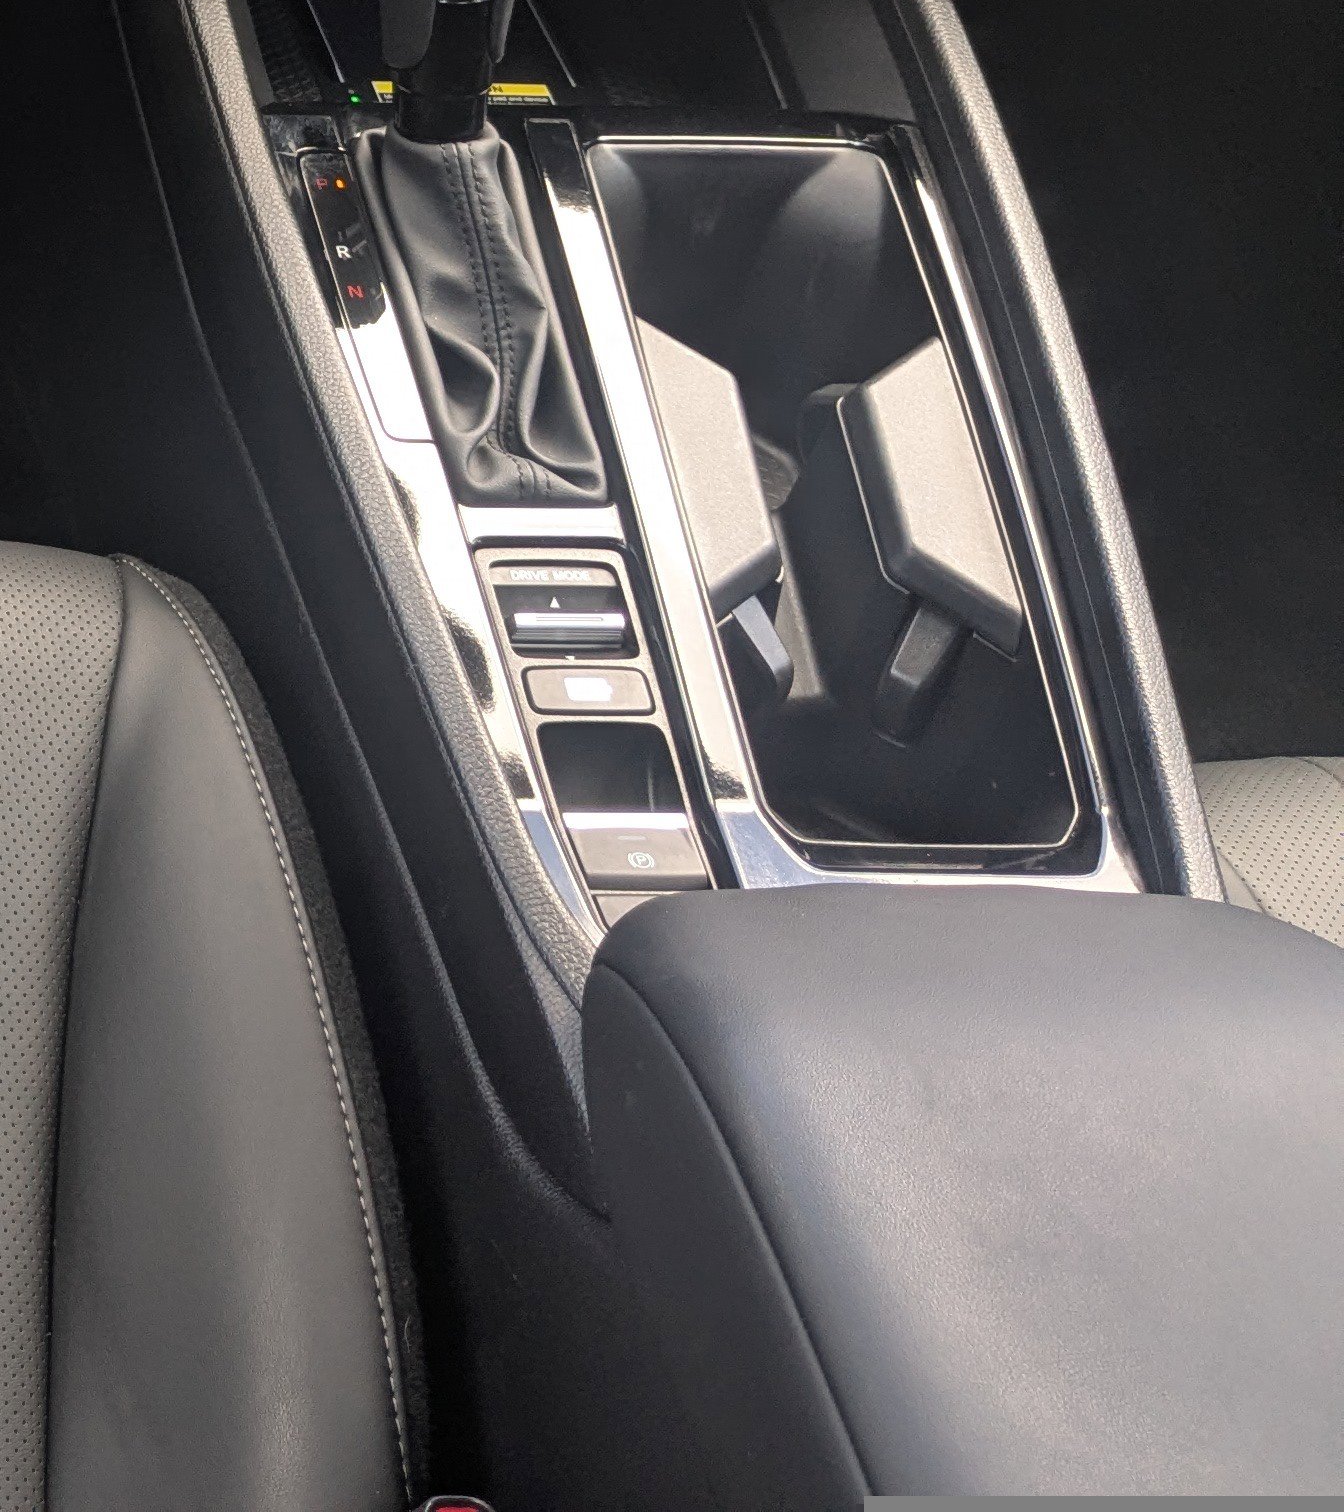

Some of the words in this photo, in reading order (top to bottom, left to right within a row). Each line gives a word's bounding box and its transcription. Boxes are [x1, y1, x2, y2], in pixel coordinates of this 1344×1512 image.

[336, 245, 352, 259] R
[347, 285, 364, 299] N
[509, 569, 550, 582] DRIVE
[552, 570, 591, 582] MODE
